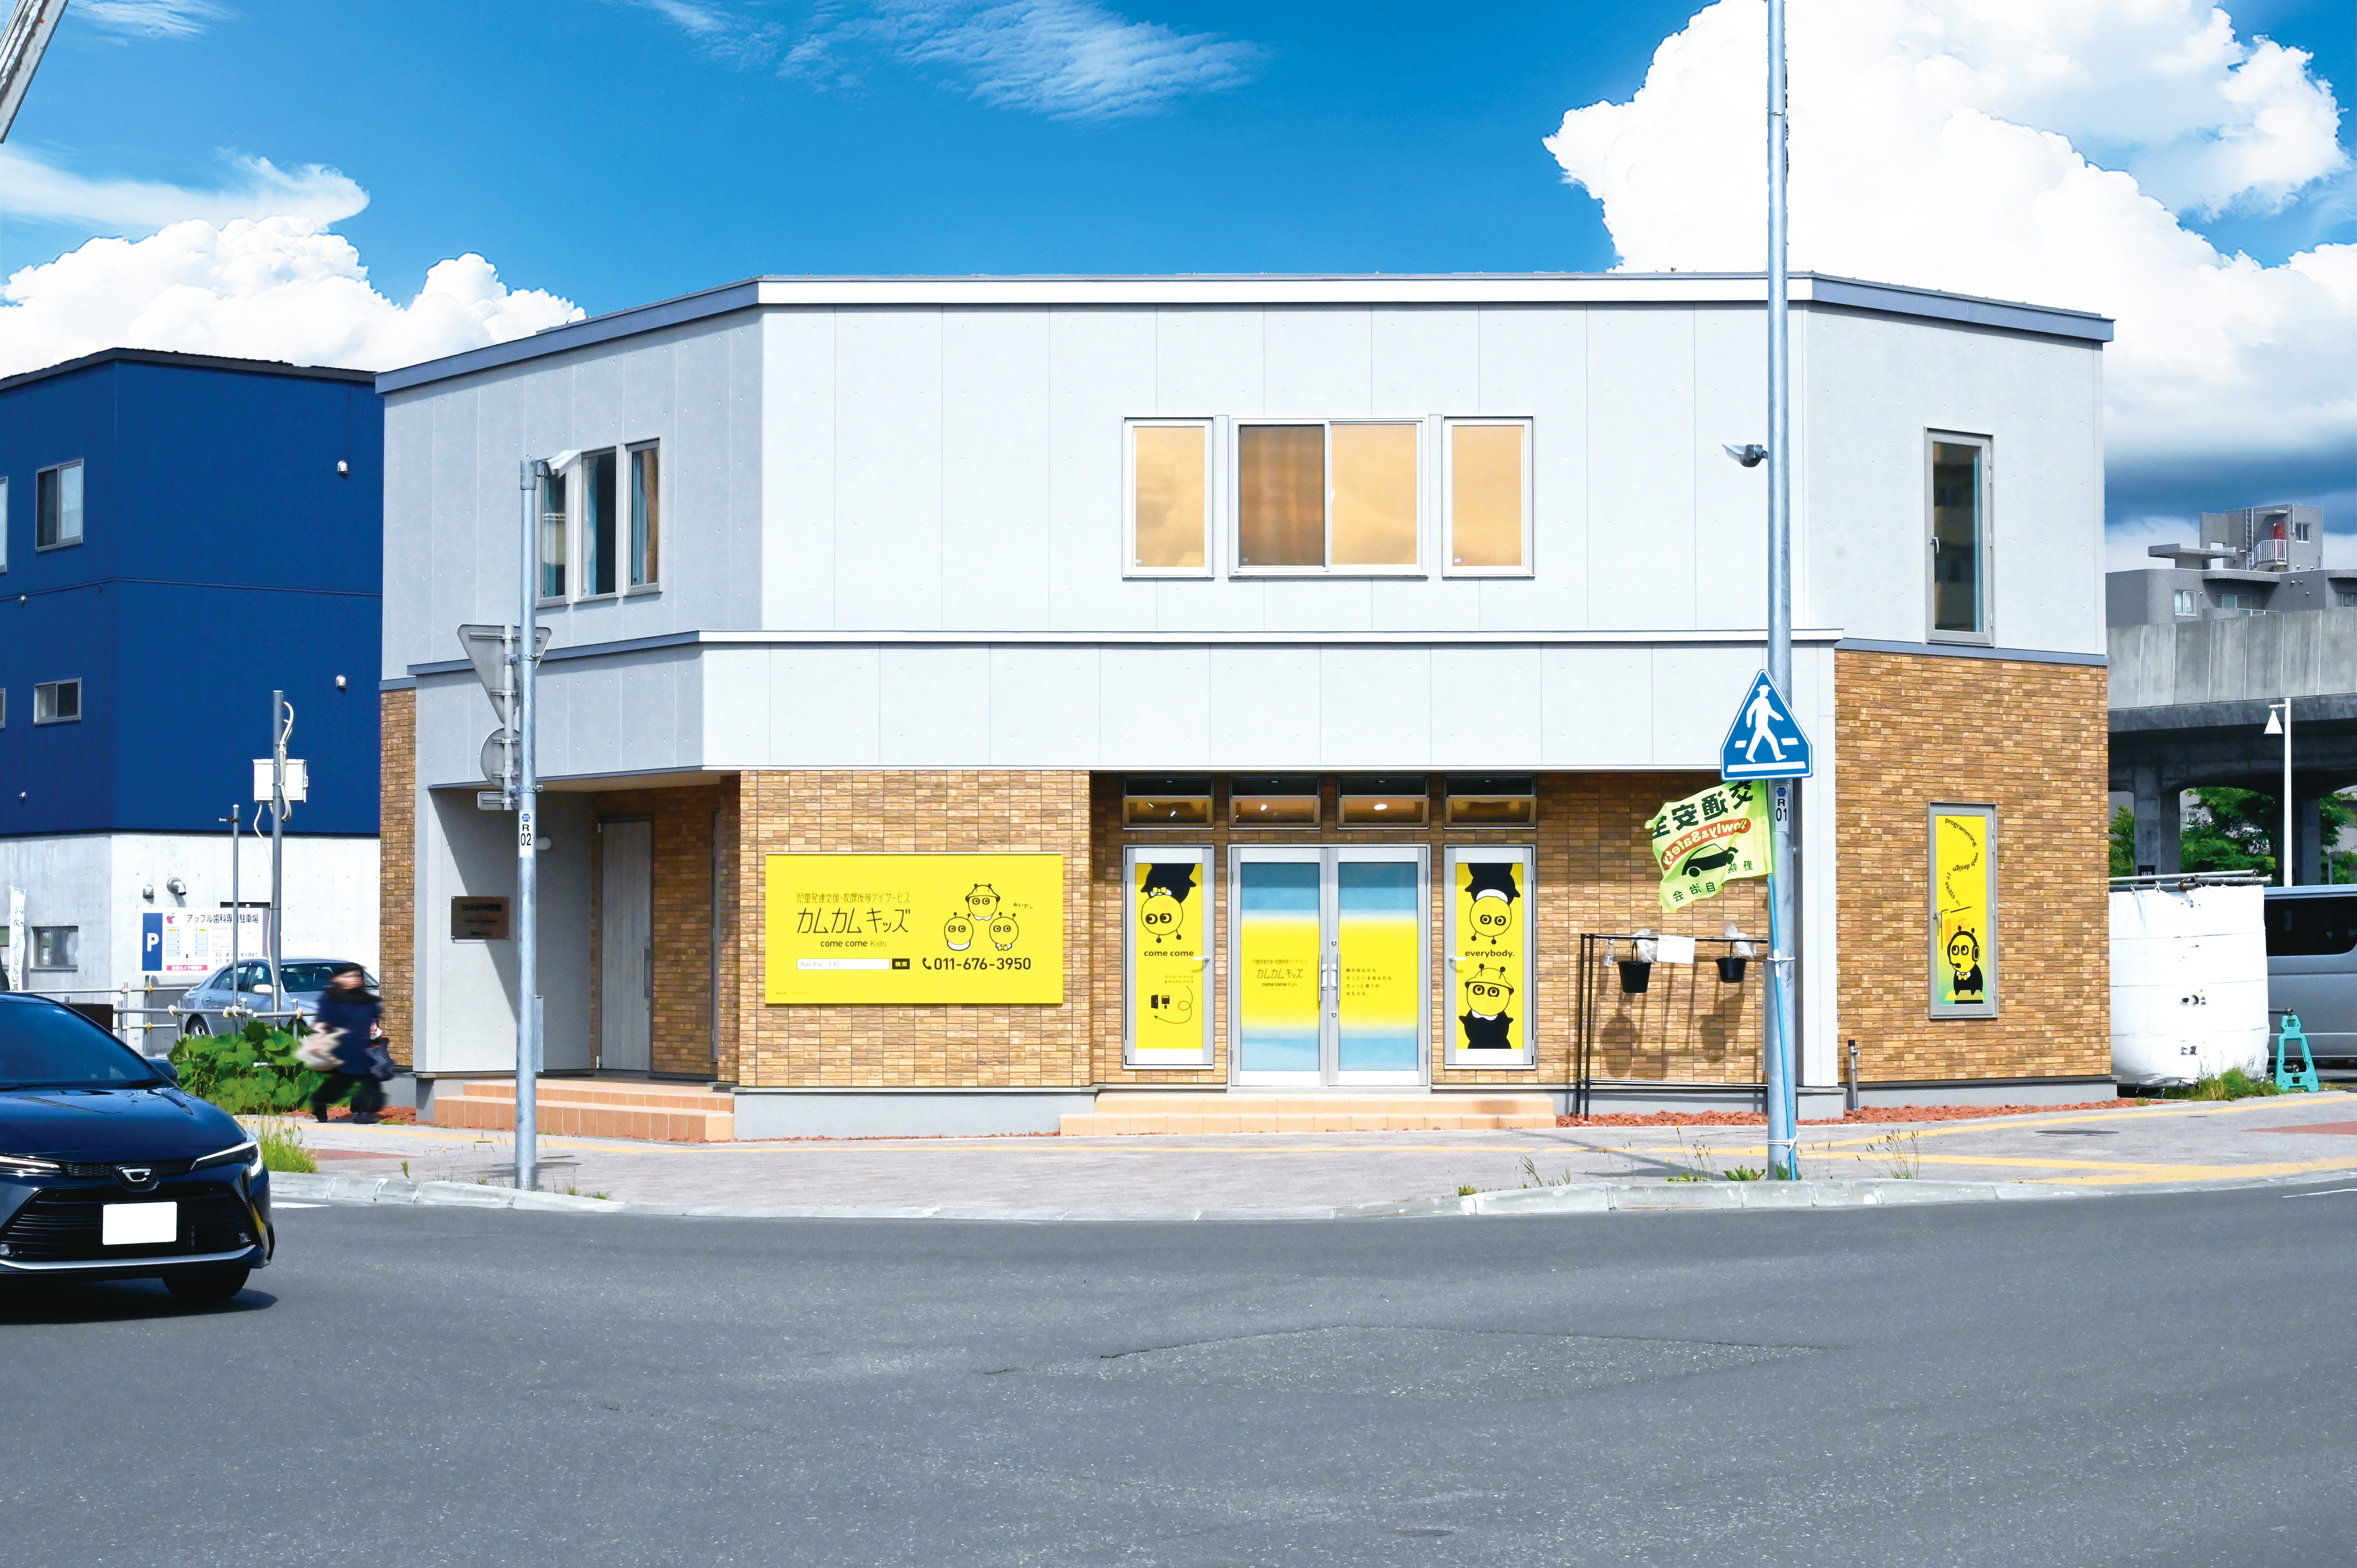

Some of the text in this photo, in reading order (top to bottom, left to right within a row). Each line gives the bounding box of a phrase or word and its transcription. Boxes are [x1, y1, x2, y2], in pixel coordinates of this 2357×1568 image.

[1776, 808, 1787, 822] 01
[521, 833, 531, 846] 02
[1945, 818, 1977, 848] programming
[1971, 852, 1979, 867] web
[1945, 871, 1956, 899] IT skills
[797, 892, 910, 903] 児童発達支援・放課後等デイサービス
[187, 914, 259, 923] アップル歯科専駐車場
[147, 932, 159, 952] P
[1465, 950, 1515, 958] everybody.
[934, 958, 1031, 970] 011-676-3950
